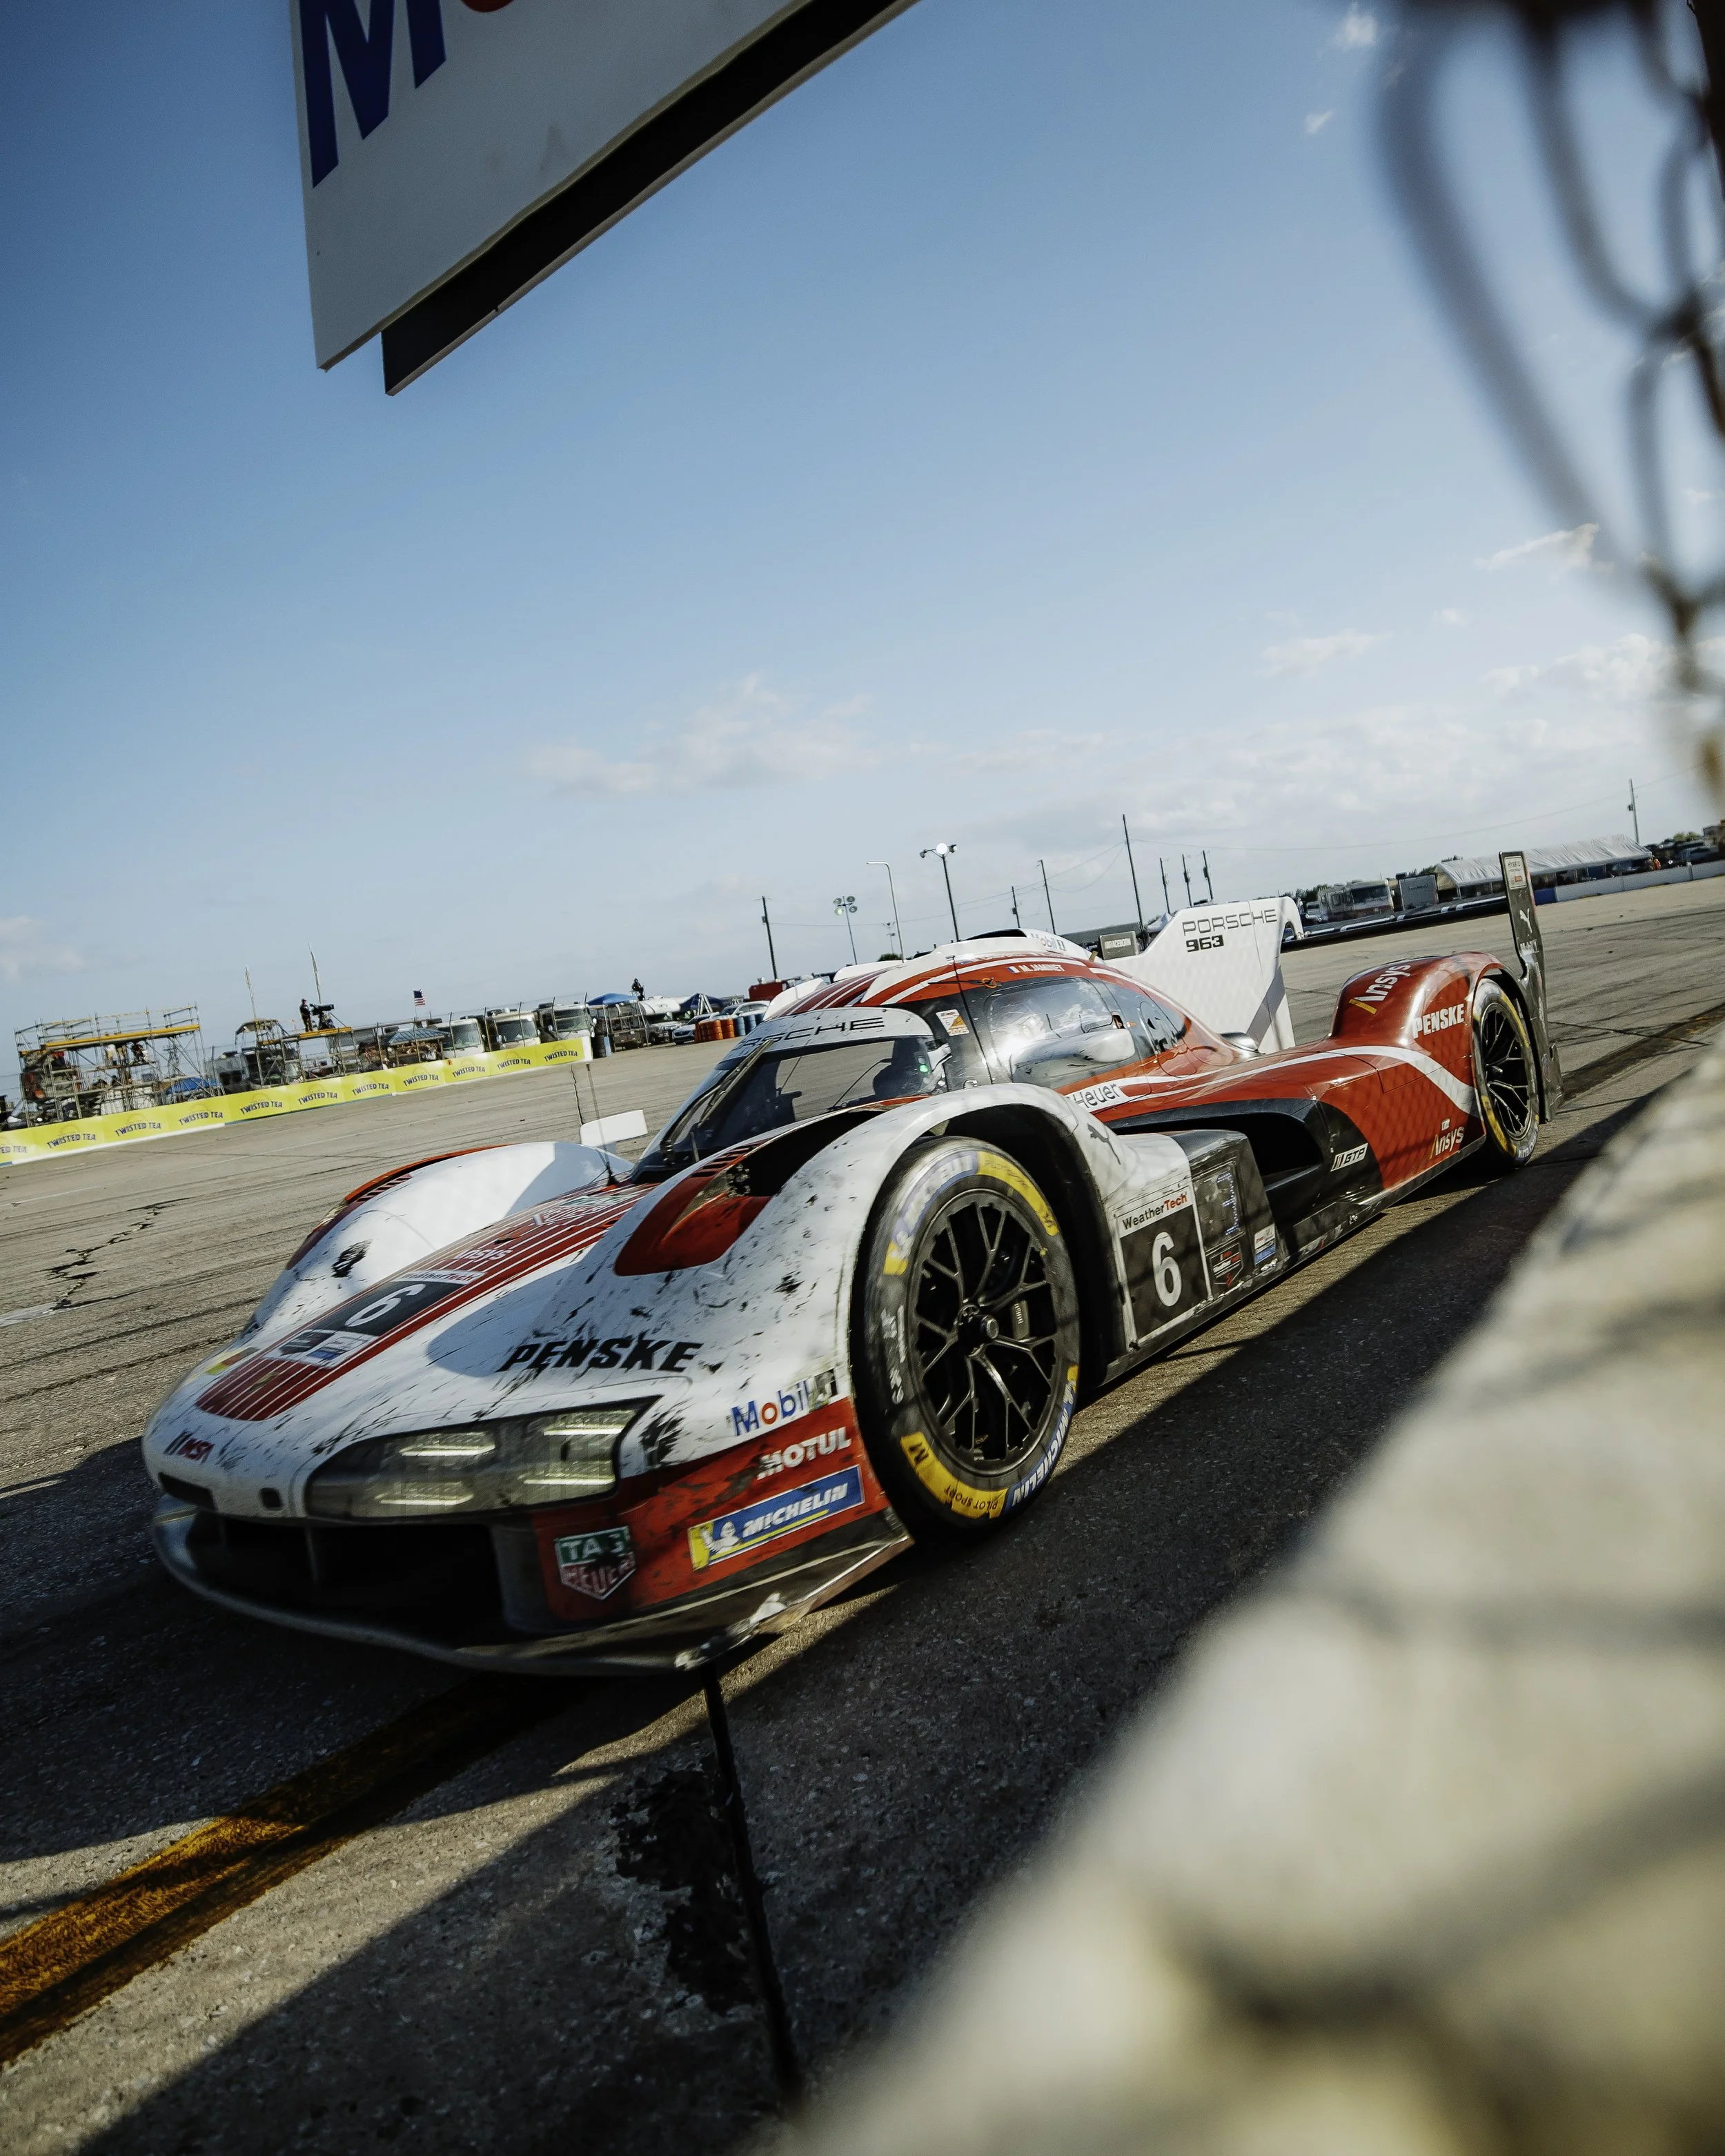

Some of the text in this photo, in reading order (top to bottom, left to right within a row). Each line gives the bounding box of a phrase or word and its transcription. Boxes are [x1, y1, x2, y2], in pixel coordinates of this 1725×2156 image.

[299, 0, 515, 188] M
[1182, 909, 1277, 936] PORSCHE
[1185, 934, 1224, 952] 963
[1349, 965, 1411, 1015] Ansys
[1412, 1003, 1465, 1039] PENSKE
[497, 1058, 520, 1070] TWISTED
[544, 1051, 567, 1062] TWISTED
[402, 1075, 428, 1087] TWISTED
[452, 1066, 475, 1078] TWISTED
[298, 1092, 325, 1105] TWISTED
[352, 1084, 377, 1096] TWISTED
[1073, 1083, 1120, 1109] Heuer
[178, 1111, 208, 1126] TWISTED
[239, 1101, 269, 1115] TWISTED
[46, 1134, 81, 1149] TWISTED
[115, 1122, 146, 1136] TWISTED
[1345, 1147, 1367, 1164] GTP
[1429, 1126, 1465, 1160] Ansys
[1122, 1191, 1187, 1230] WeatherTech
[1152, 1232, 1182, 1307] 6
[344, 1283, 426, 1327] 6
[495, 1338, 704, 1372] PENSKE
[731, 1380, 810, 1436] Mobil
[1012, 1407, 1069, 1507] MICHELIN
[944, 1484, 998, 1510] PILOT SPORT
[742, 1483, 848, 1538] MICHELIN
